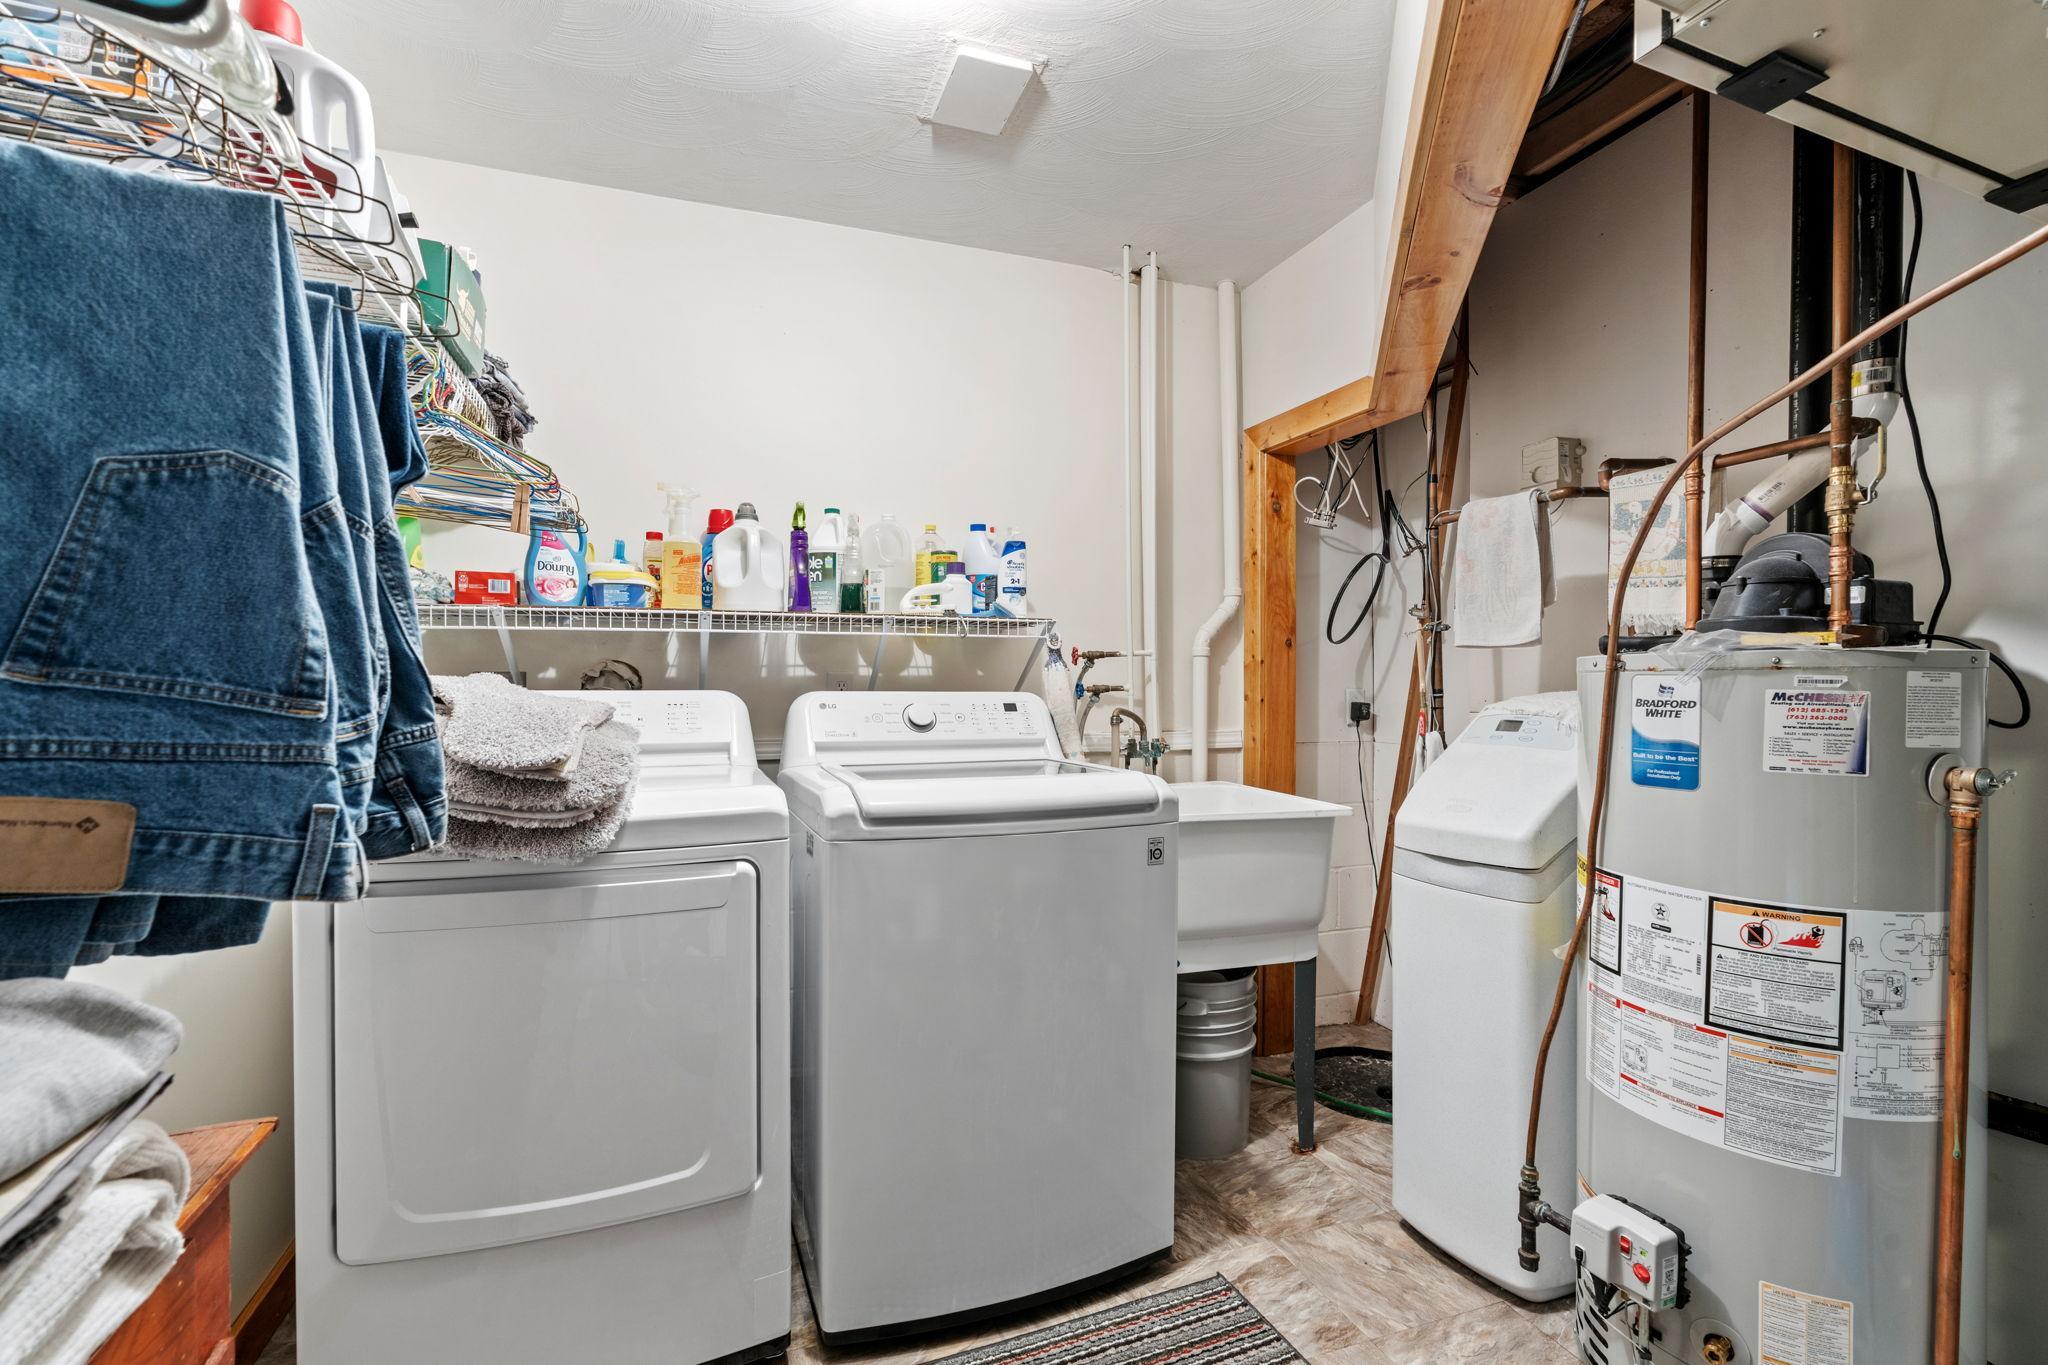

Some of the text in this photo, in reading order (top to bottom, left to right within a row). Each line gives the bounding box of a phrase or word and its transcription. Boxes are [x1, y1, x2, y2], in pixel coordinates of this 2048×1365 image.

[537, 560, 575, 576] Downy
[1635, 698, 1697, 709] BRADFORD
[1645, 708, 1682, 718] WHITE
[1761, 912, 1801, 922] WARNING
